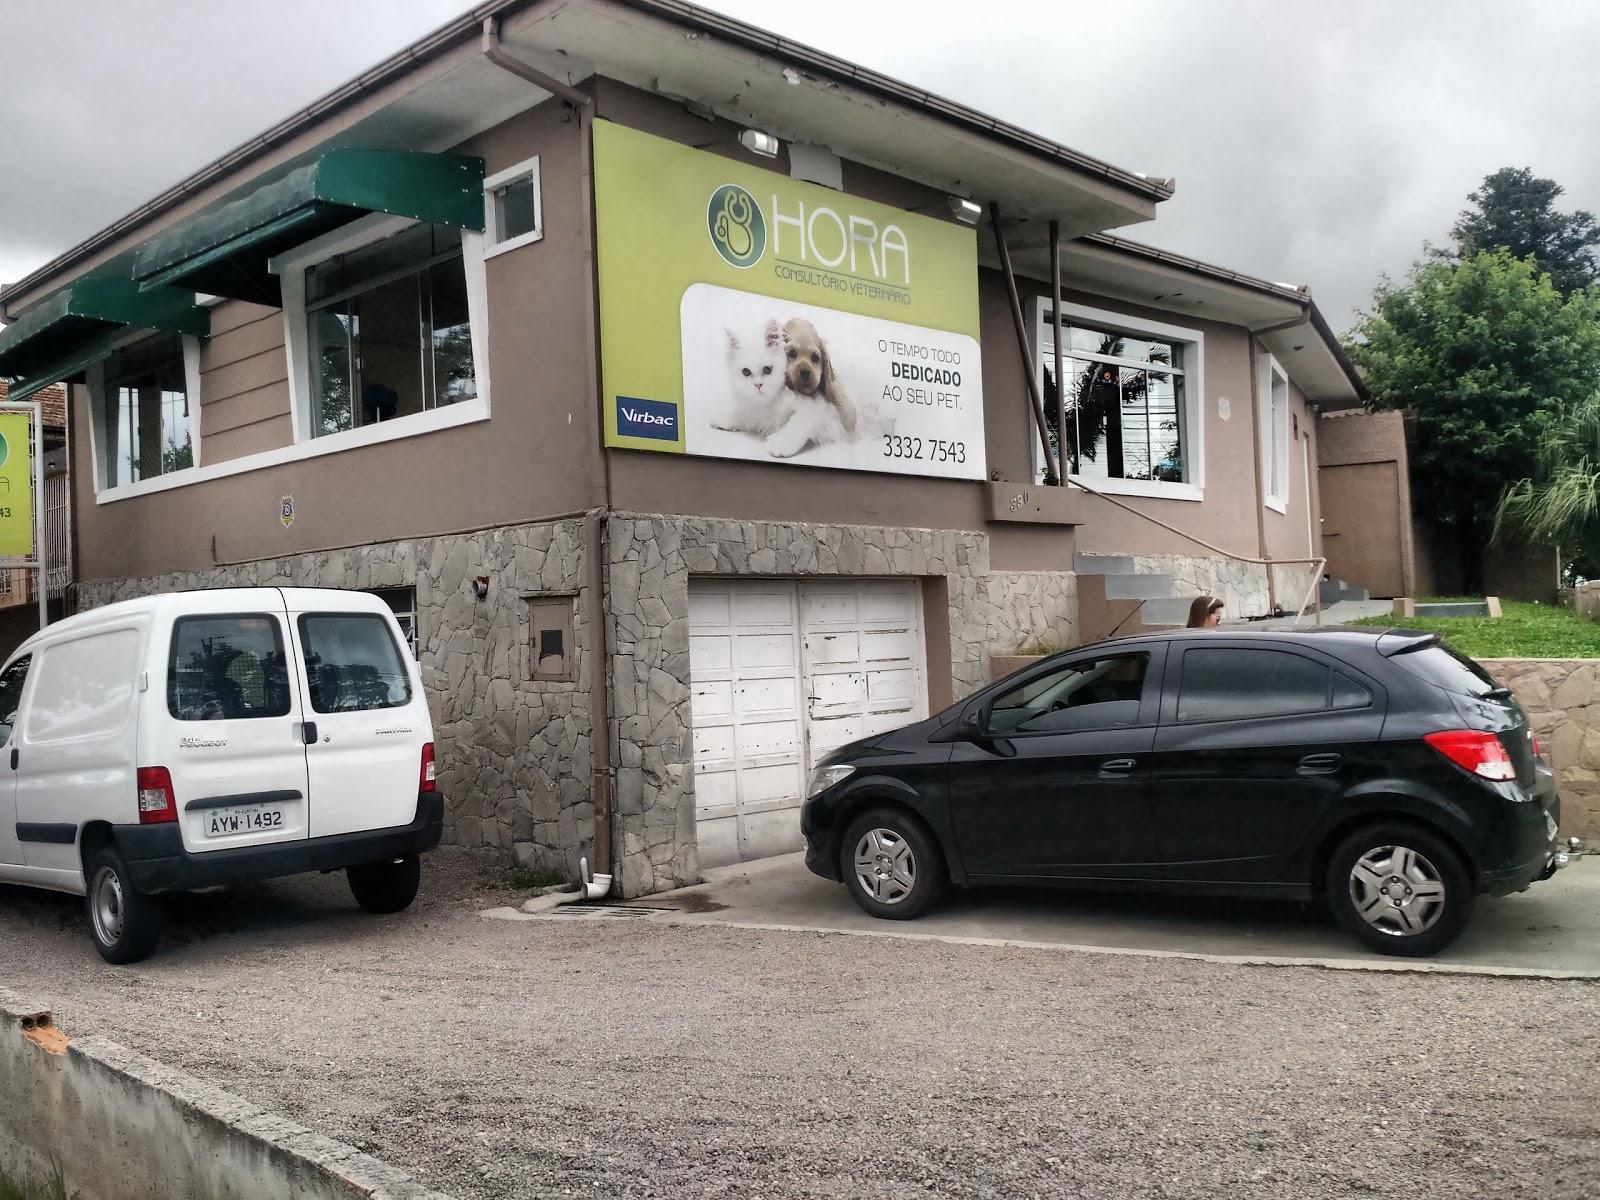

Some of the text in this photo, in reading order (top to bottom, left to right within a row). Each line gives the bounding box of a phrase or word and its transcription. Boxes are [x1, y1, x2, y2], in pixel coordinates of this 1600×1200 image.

[772, 194, 910, 284] HORA
[774, 265, 911, 305] CONSULTÓRIO VETERINÁRIO
[878, 339, 961, 365] O TEMPO TODO
[891, 361, 961, 387] DEDICADO
[882, 384, 962, 410] AO SEU PET.
[621, 407, 674, 426] Virbac
[883, 434, 966, 463] 3332 7543
